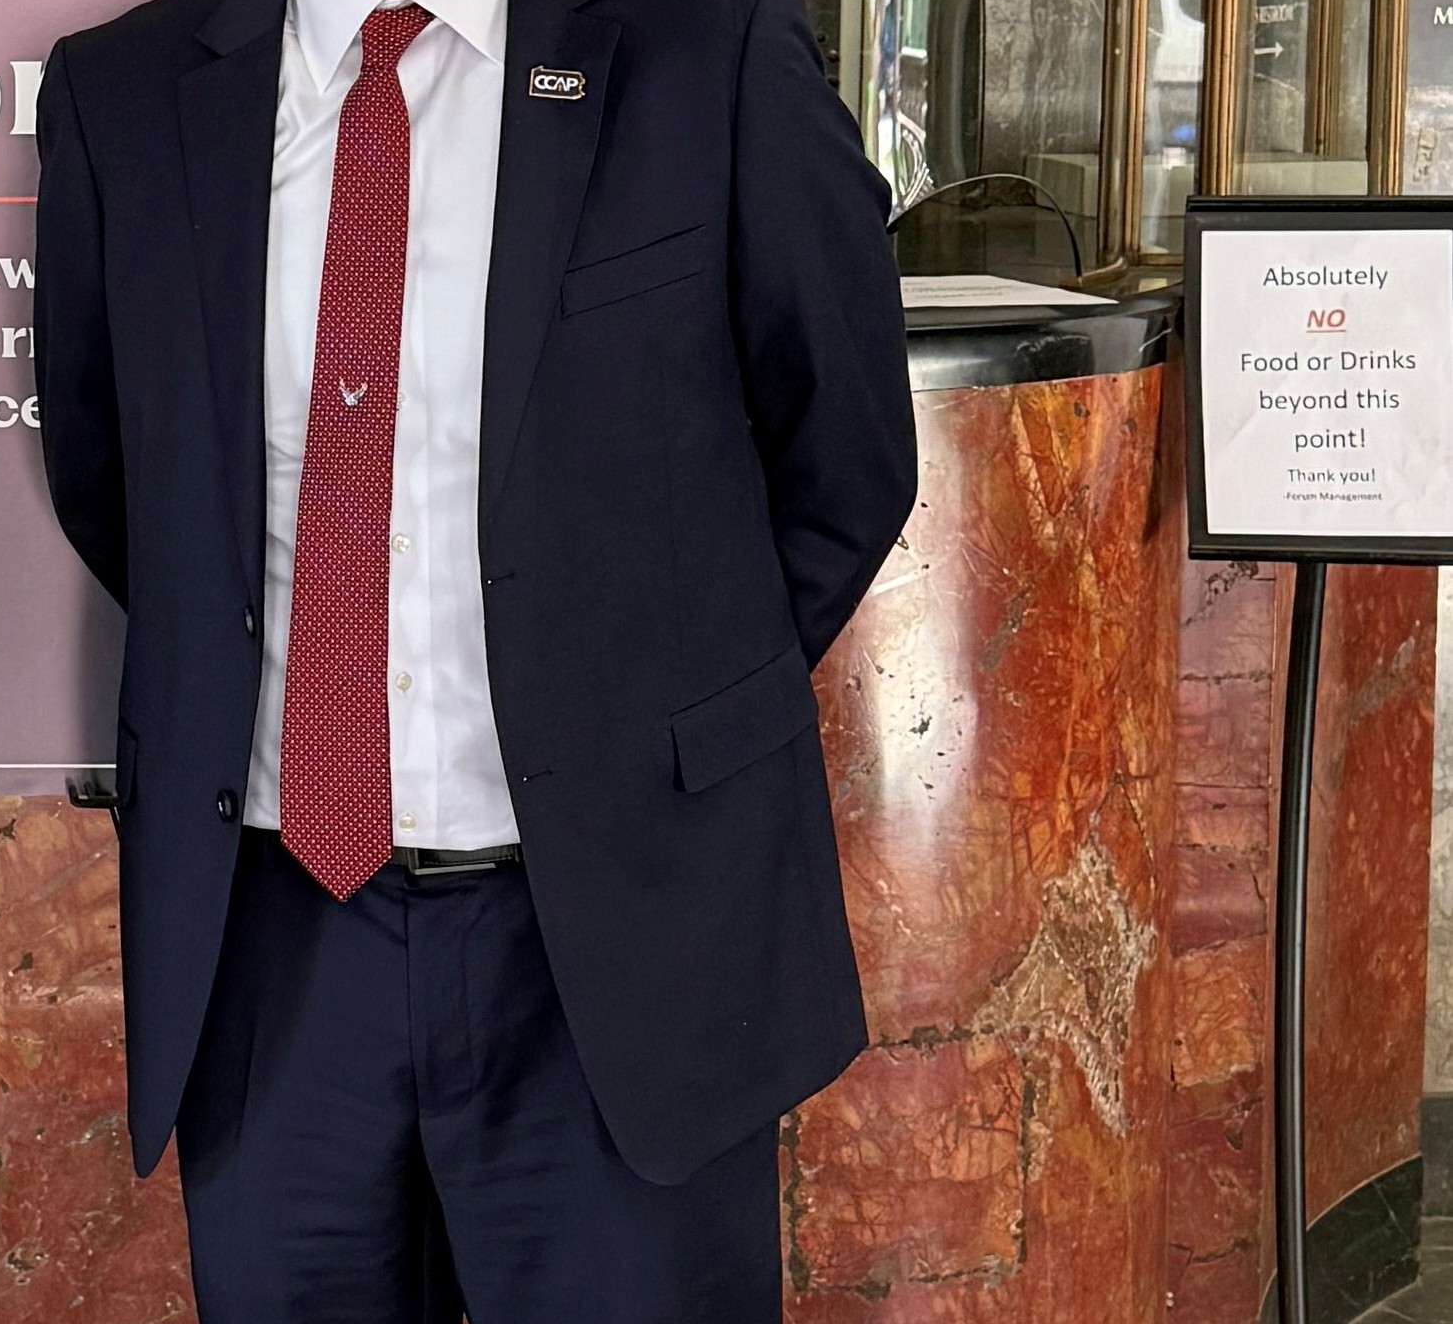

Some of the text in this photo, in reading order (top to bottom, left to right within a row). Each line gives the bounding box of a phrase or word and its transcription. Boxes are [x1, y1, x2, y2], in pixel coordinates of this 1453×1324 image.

[534, 75, 579, 91] CCAP
[1262, 265, 1388, 289] Absolutely
[1306, 309, 1346, 329] NO
[1241, 349, 1416, 371] Food or Drinks
[1259, 389, 1400, 414] beyond this
[1295, 428, 1365, 452] point!
[1287, 468, 1376, 484] Thank you!
[1319, 492, 1383, 502] Management
